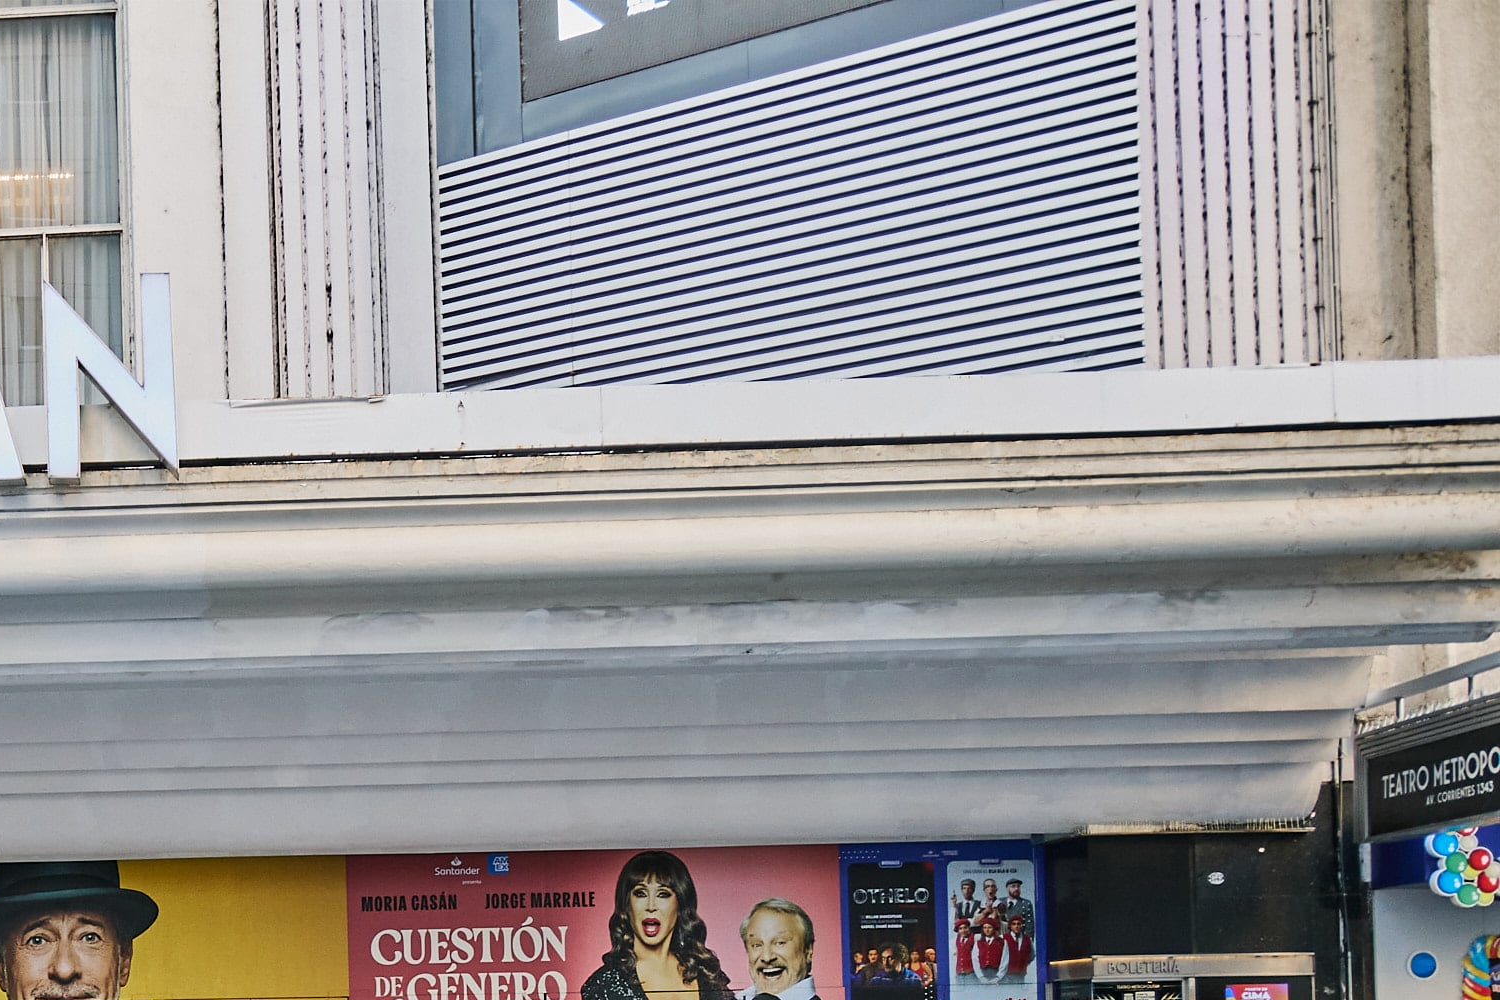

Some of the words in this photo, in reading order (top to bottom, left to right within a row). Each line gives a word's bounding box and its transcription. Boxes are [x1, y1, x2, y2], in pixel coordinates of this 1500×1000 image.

[1382, 766, 1430, 799] TEATRO
[1437, 784, 1476, 803] CORRIENTES
[1477, 780, 1494, 794] 1343
[434, 866, 480, 876] Santander
[361, 896, 407, 912] MORIA
[411, 892, 458, 911] CASÁN
[485, 893, 526, 910] JORGE
[531, 891, 596, 908] MARRALE
[853, 887, 930, 904] OTHELO
[370, 916, 568, 966] CUESTIÓN
[375, 976, 404, 998] DE
